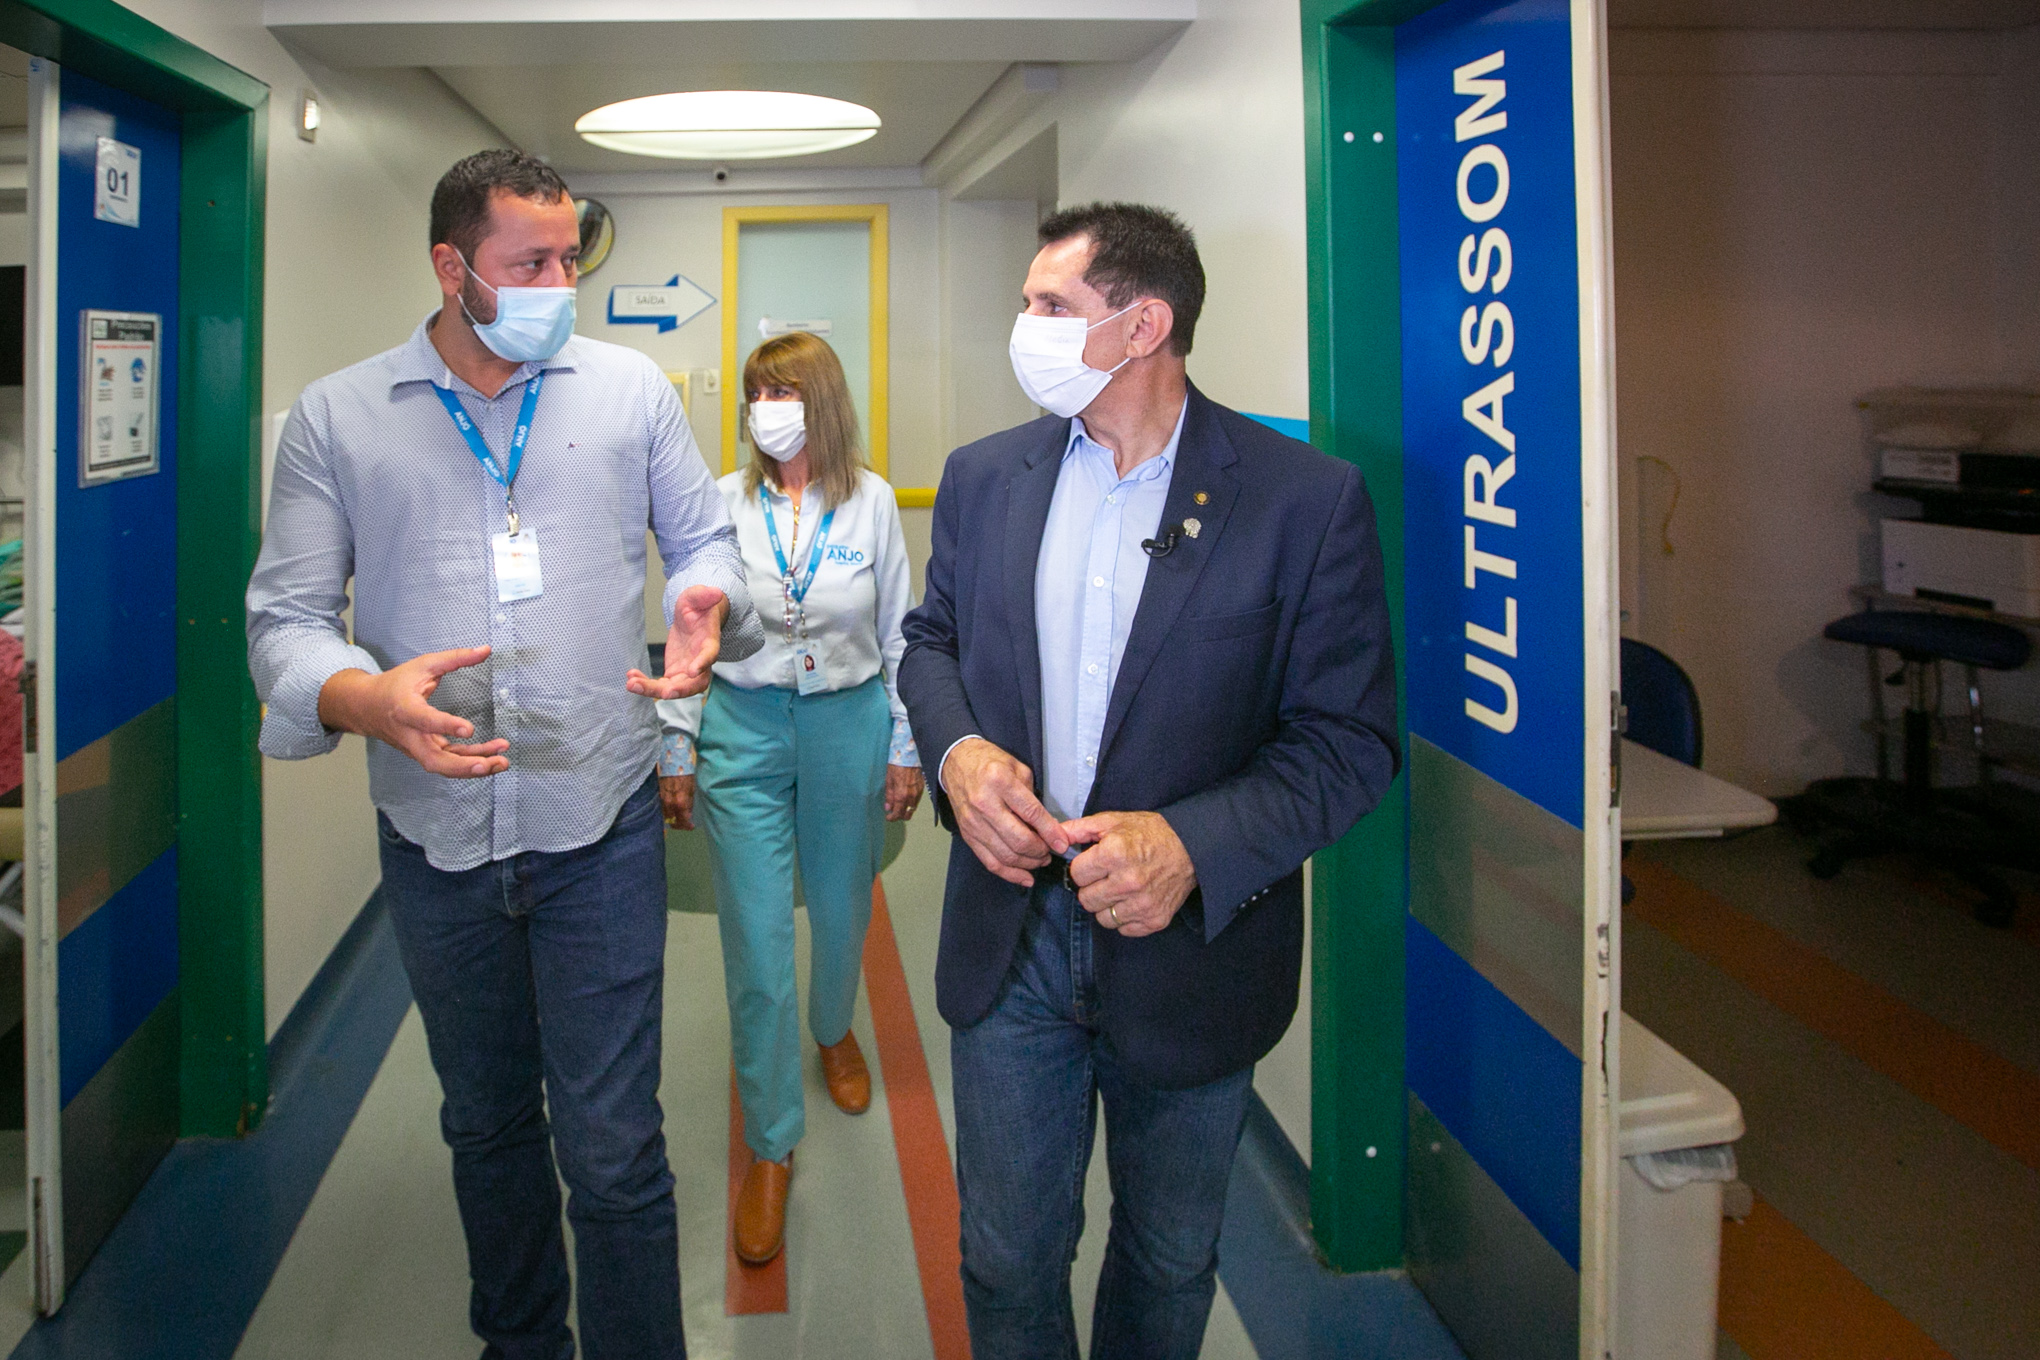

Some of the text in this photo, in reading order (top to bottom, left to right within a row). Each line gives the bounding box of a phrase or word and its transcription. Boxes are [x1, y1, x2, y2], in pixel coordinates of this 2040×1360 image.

[107, 167, 129, 196] 01
[635, 292, 666, 305] SAÍDA
[1453, 49, 1519, 734] ULTRASSOM
[454, 411, 471, 431] ANJO
[515, 425, 527, 448] ANJO
[483, 457, 501, 478] ANJO
[827, 549, 864, 562] ANJO
